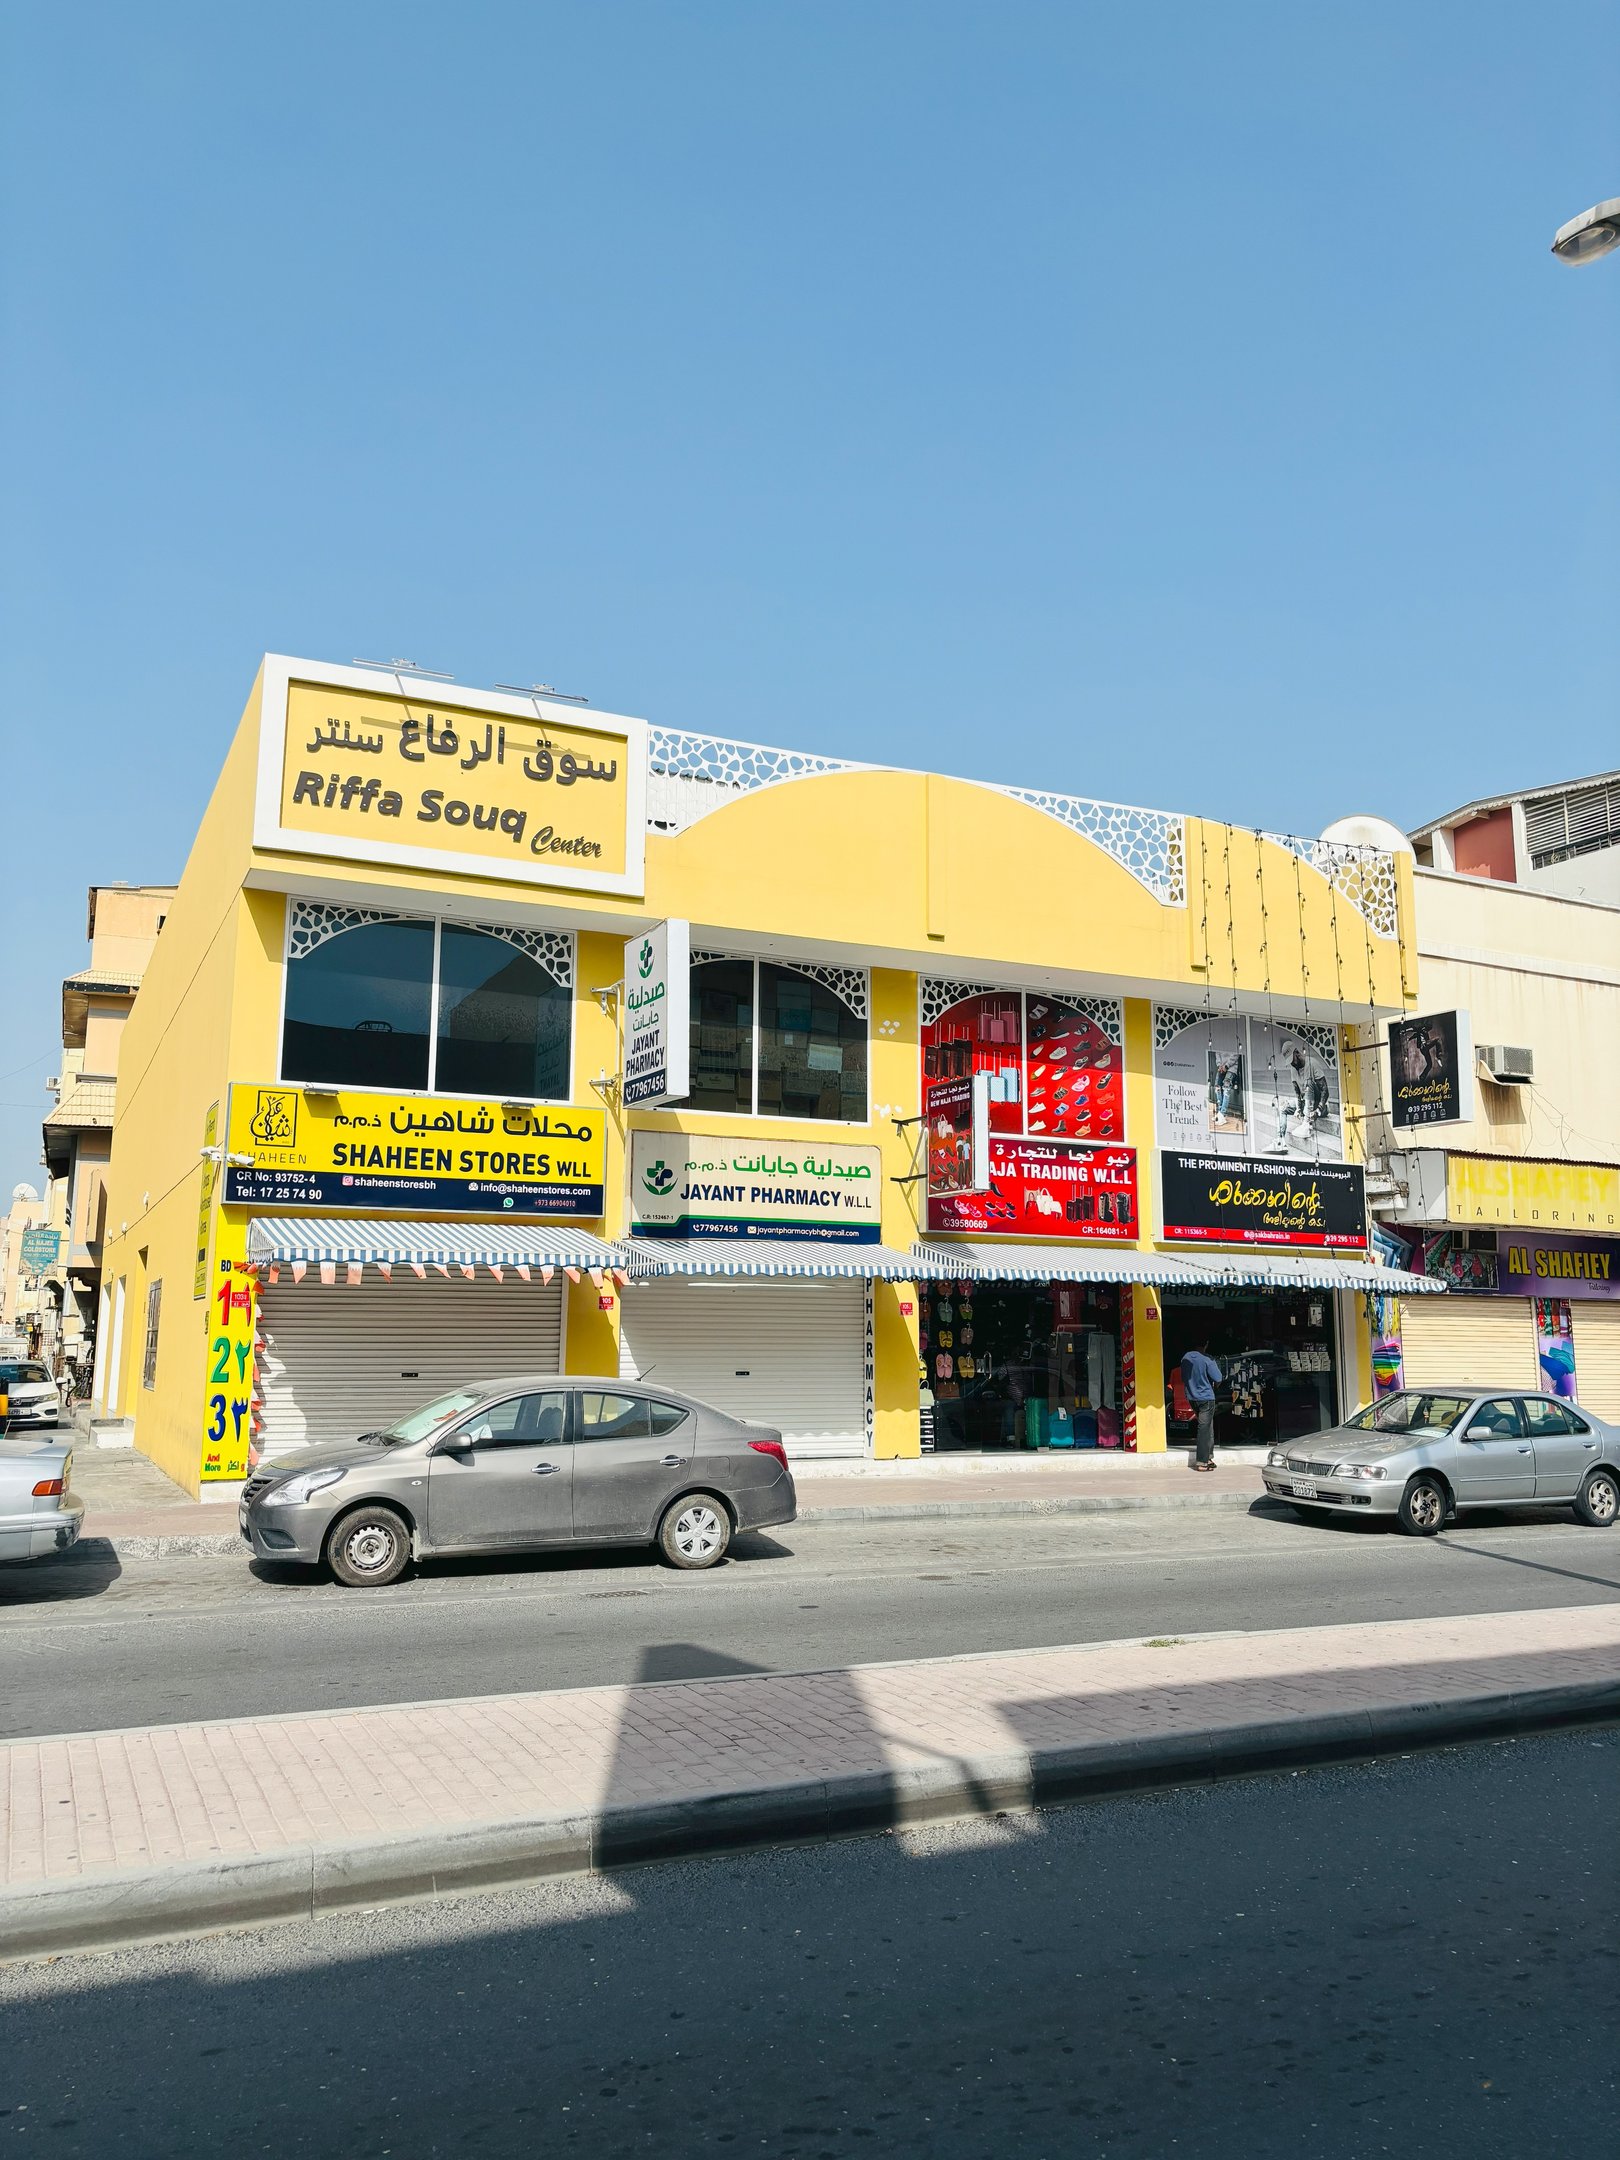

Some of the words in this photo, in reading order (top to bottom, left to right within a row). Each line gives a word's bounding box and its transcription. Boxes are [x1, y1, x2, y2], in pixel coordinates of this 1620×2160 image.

[306, 717, 384, 753] سنتر
[398, 714, 506, 770] الرفاع
[523, 739, 618, 786] سوق
[292, 770, 404, 818] Riffa
[417, 789, 527, 843] Souq
[530, 826, 602, 858] Center
[628, 981, 665, 1014] صيدلية
[633, 1009, 659, 1032] جايانت
[631, 1029, 660, 1055] JAYANT
[626, 1046, 665, 1078] PHARMACY
[631, 1074, 664, 1099] 77967456
[952, 1092, 970, 1102] TRADING
[958, 1082, 970, 1092] نيو
[1168, 1085, 1197, 1097] Follow
[1162, 1099, 1181, 1111] The
[1184, 1100, 1202, 1112] Best
[334, 1114, 381, 1128] ذ.م.م
[390, 1106, 494, 1137] شاهين
[502, 1115, 592, 1142] محلات
[1167, 1113, 1199, 1125] Trends
[332, 1143, 452, 1171] SHAHEEN
[459, 1150, 550, 1176] STORES
[557, 1161, 591, 1178] WLL
[996, 1144, 1057, 1161] للتجارة
[1069, 1149, 1094, 1162] نجا
[1106, 1153, 1129, 1167] نيو
[236, 1171, 252, 1181] CR
[254, 1172, 272, 1182] No:
[733, 1155, 798, 1178] جايانت
[803, 1156, 871, 1181] صيدلية
[1021, 1163, 1088, 1182] TRADING
[1094, 1168, 1132, 1185] W.L.L
[1178, 1157, 1197, 1169] THE
[1198, 1159, 1252, 1174] PROMINENT
[1253, 1163, 1296, 1176] FASHIONS
[236, 1186, 257, 1197] Tel:
[260, 1188, 271, 1198] 17
[276, 1189, 290, 1198] 25
[293, 1189, 306, 1199] 74
[308, 1189, 322, 1200] 90
[354, 1178, 436, 1189] shaheenstoresbh
[480, 1182, 591, 1196] info@shaheenstores.com
[680, 1184, 746, 1203] JAYANT
[751, 1187, 841, 1207] PHARMACY
[844, 1196, 872, 1208] W.L.L
[700, 1223, 738, 1233] 77967456
[757, 1226, 859, 1237] jayantpharmacybh@gmail.com
[950, 1218, 988, 1229] 39580669
[220, 1260, 232, 1272] BD
[1508, 1247, 1531, 1275] AL
[1535, 1250, 1610, 1280] SHAFIEY
[217, 1279, 231, 1326] 1
[210, 1336, 231, 1383] 2
[235, 1339, 251, 1384] ٢
[865, 1278, 874, 1448] PHARMACY
[208, 1393, 227, 1442] 3
[231, 1397, 249, 1443] ٣
[204, 1463, 221, 1472] More
[207, 1454, 220, 1462] And
